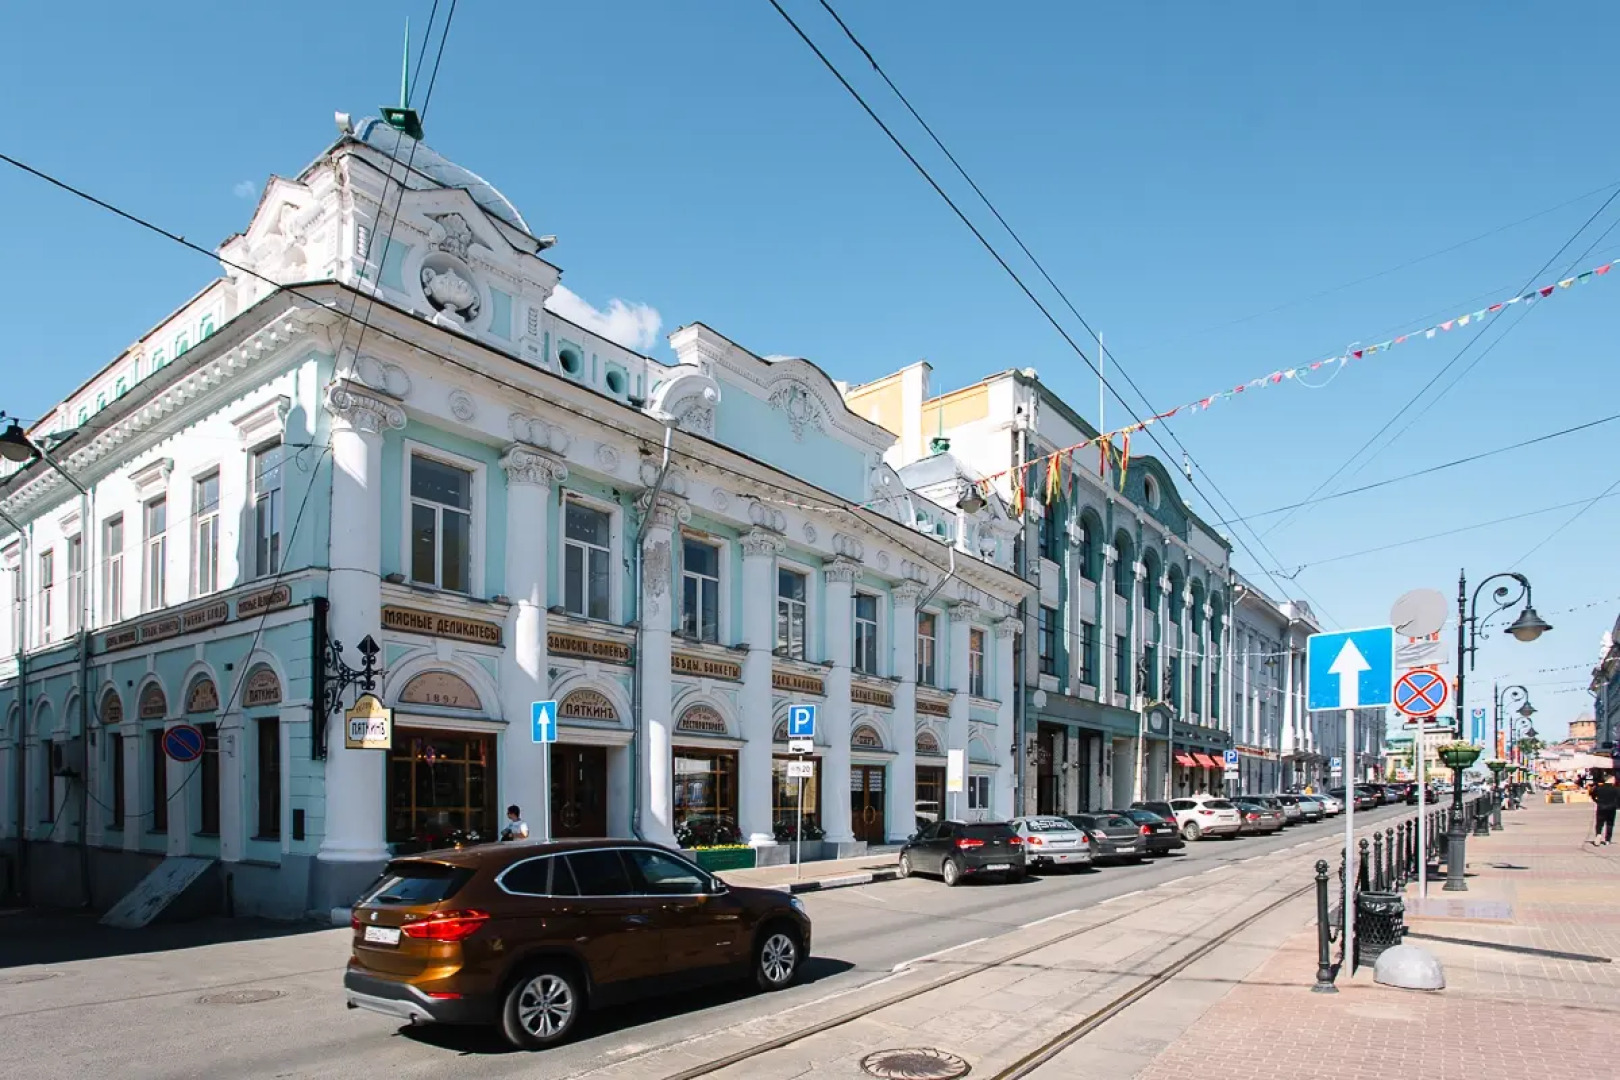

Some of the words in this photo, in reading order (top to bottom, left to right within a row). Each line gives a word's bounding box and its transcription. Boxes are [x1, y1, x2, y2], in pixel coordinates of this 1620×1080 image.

[384, 610, 433, 630] МЯСНЫЕ
[436, 619, 499, 641] ДЕЛИКАТЕСЫ
[592, 642, 629, 660] СОЛЕНЬЯ
[704, 662, 738, 677] БАНКЕТЫ
[426, 693, 459, 704] 1897
[566, 702, 614, 719] ПЯТКИНЪ
[351, 721, 386, 735] ПЯТКИНЪ
